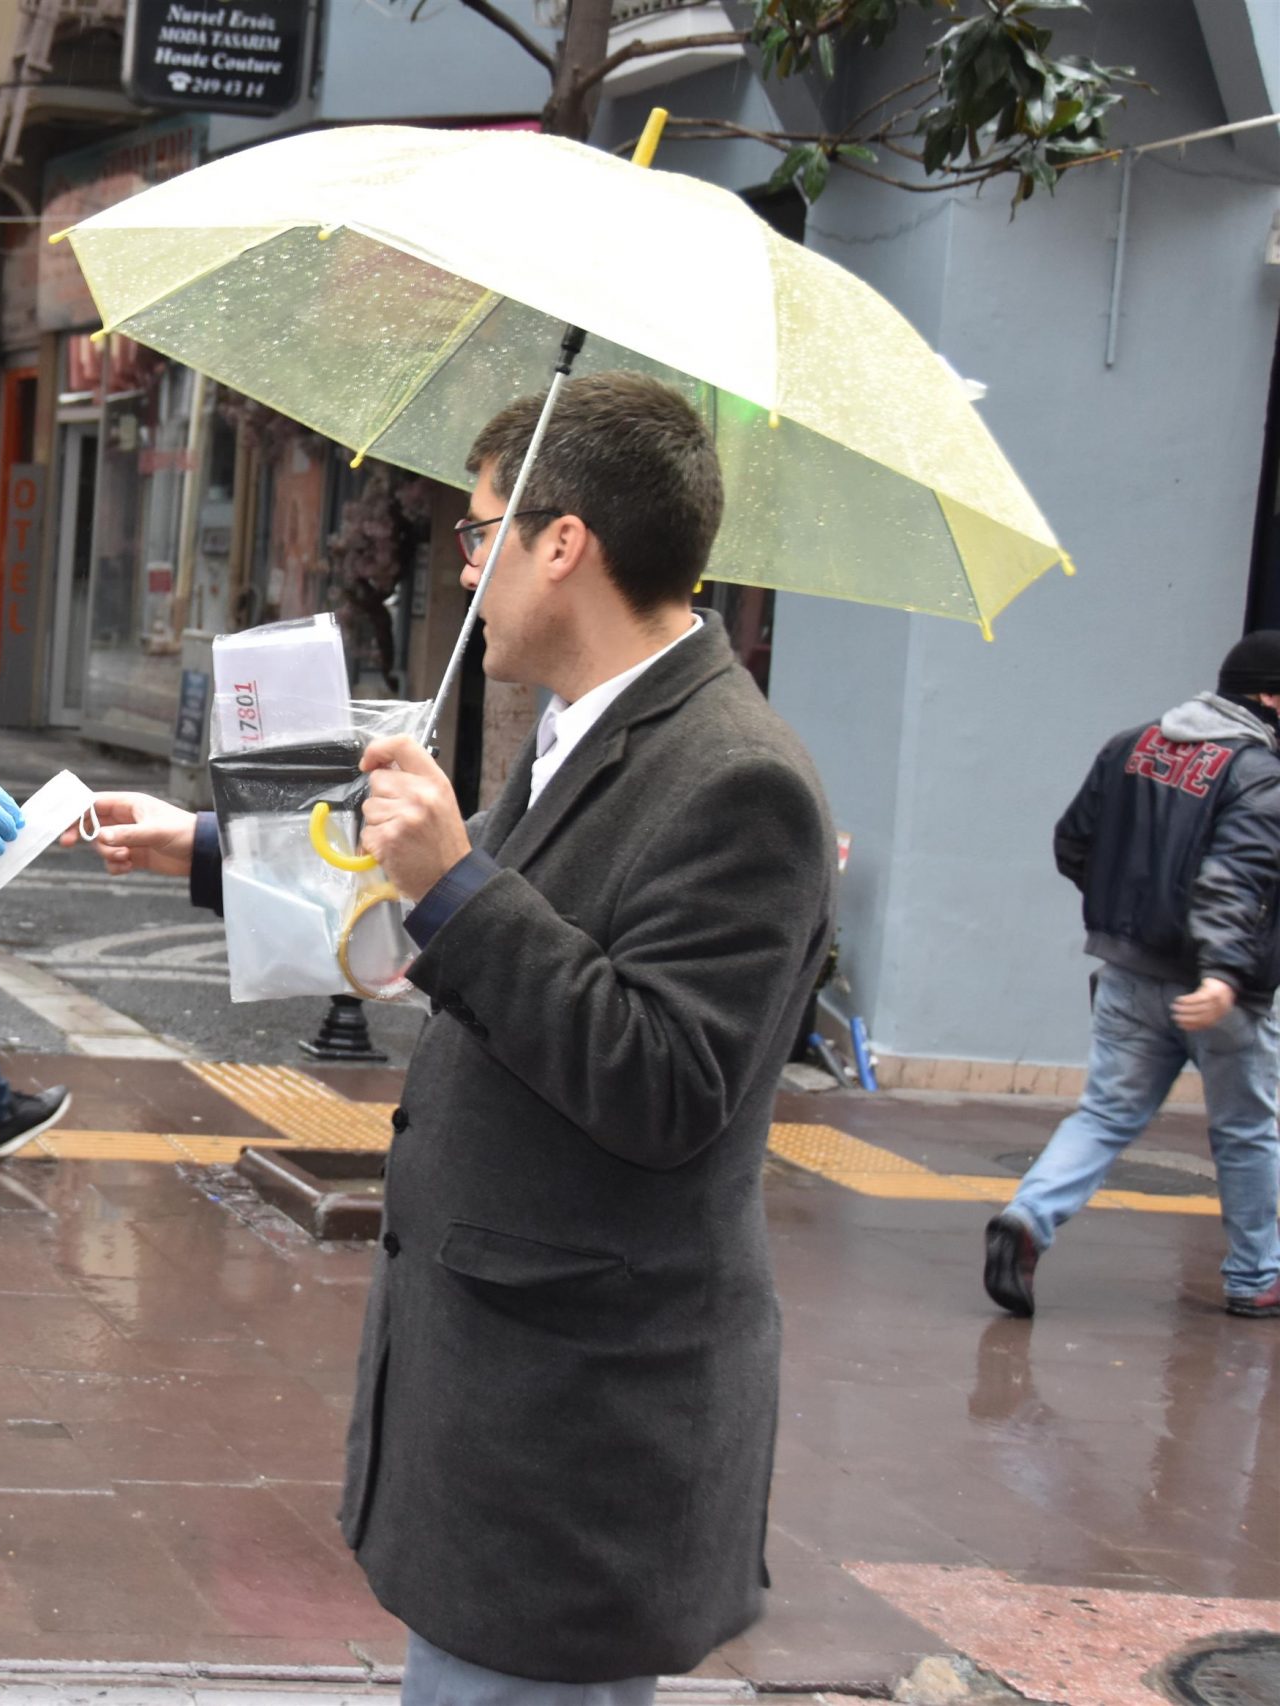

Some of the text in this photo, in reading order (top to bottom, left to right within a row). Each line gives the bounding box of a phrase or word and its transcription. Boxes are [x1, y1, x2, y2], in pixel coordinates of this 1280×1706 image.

[158, 26, 207, 46] MODA
[211, 52, 283, 75] Couture
[8, 479, 38, 635] OTEL
